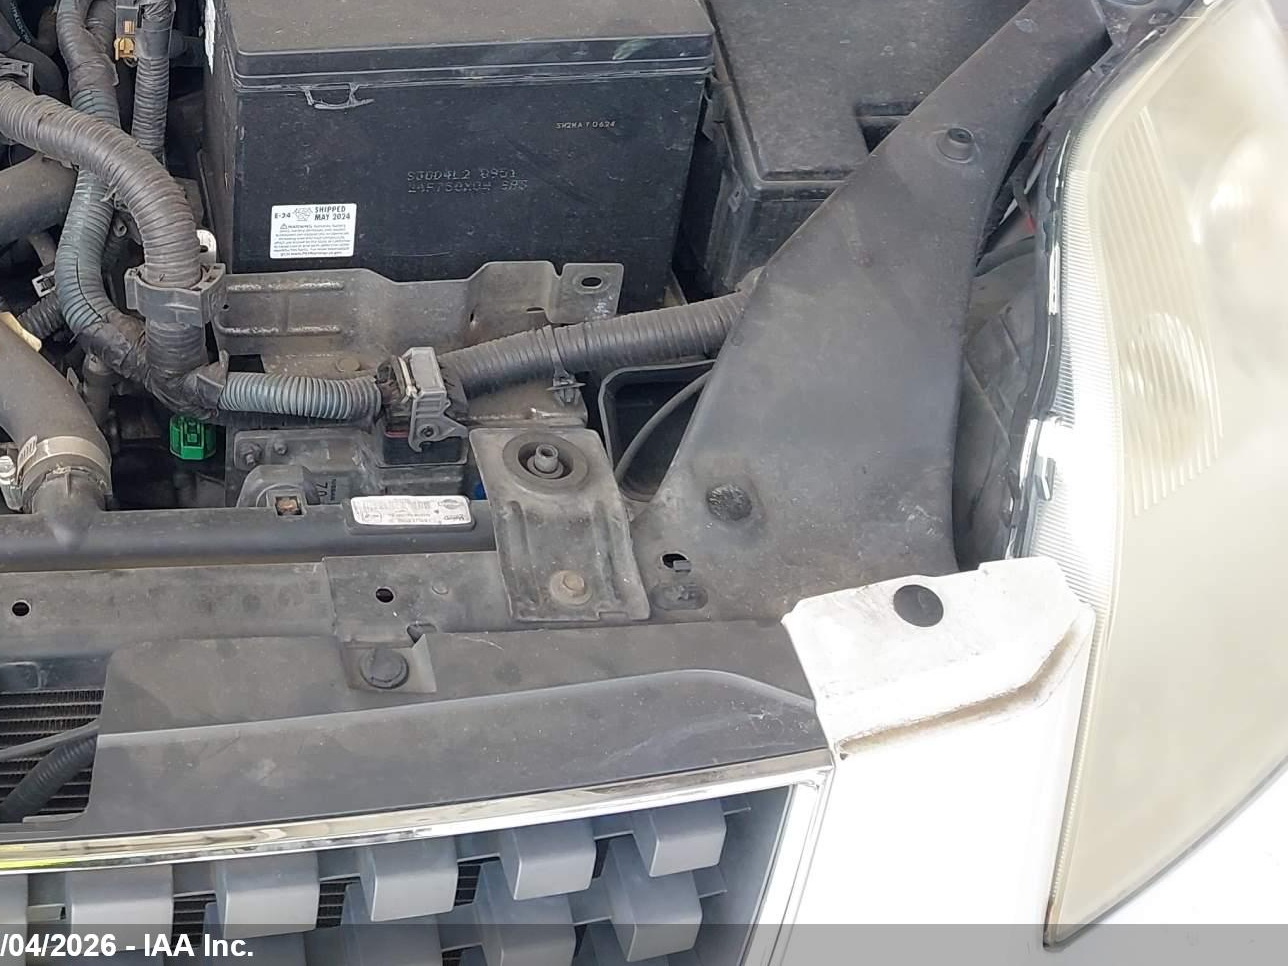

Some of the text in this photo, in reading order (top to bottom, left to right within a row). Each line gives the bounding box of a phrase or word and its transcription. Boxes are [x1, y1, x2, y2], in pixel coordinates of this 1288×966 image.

[314, 205, 346, 214] SHIPPED
[314, 212, 351, 221] MAY 2024
